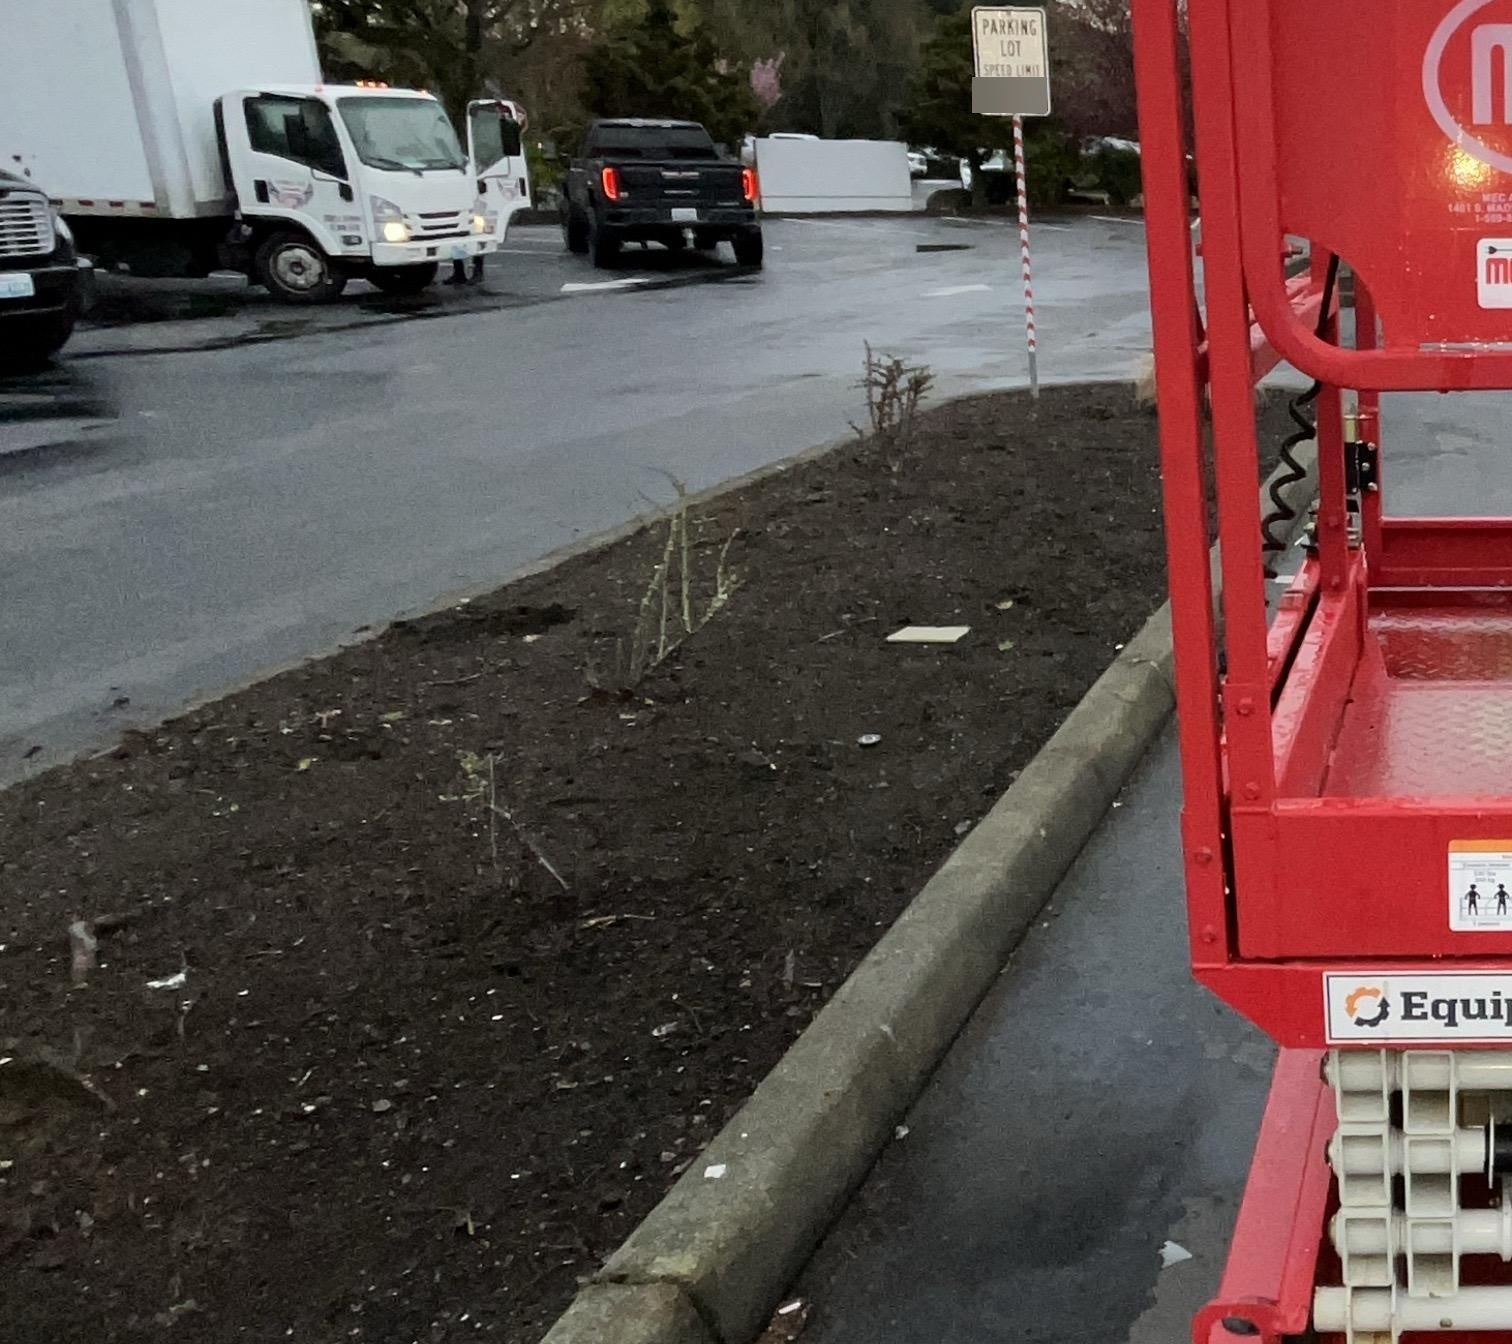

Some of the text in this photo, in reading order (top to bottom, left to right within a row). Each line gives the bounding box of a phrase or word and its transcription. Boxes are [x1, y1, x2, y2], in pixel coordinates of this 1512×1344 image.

[982, 18, 1037, 36] PARKING
[999, 39, 1022, 57] LOT
[983, 64, 1040, 77] SPEED LIMIT
[1482, 192, 1506, 203] MEC
